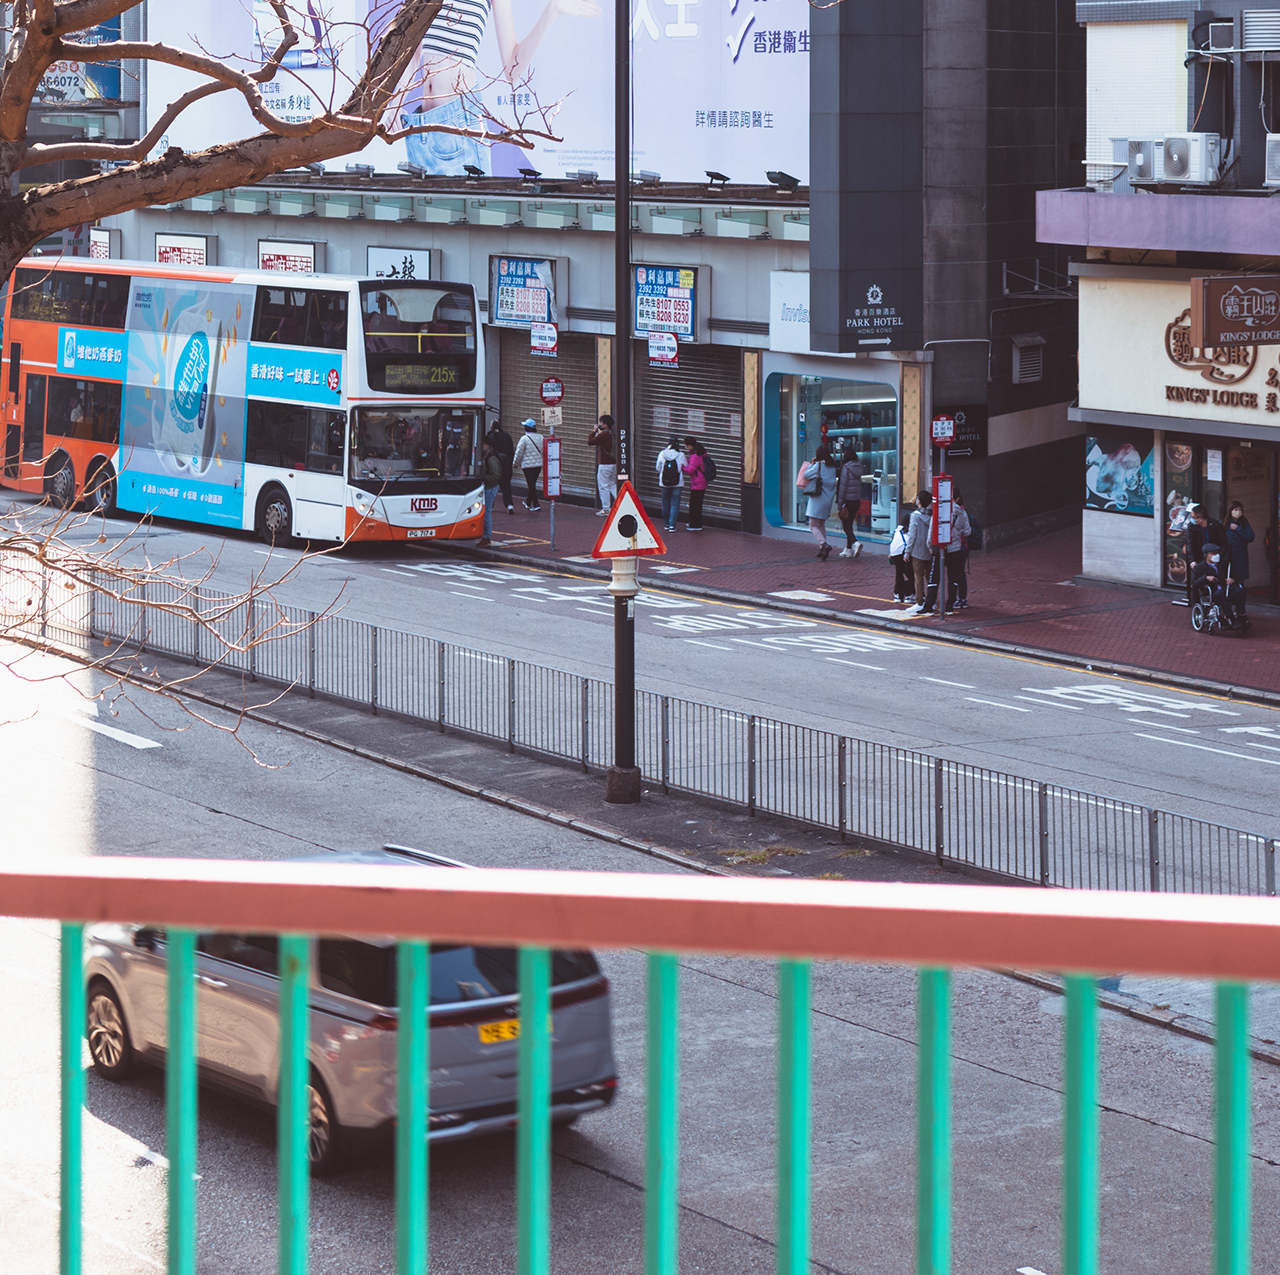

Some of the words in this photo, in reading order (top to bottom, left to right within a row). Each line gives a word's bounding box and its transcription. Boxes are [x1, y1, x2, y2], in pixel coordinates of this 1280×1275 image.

[695, 111, 774, 129] 詳情請諮詢醫生
[639, 285, 651, 293] 2392
[653, 286, 666, 294] 3392
[656, 299, 671, 310] 8107
[674, 300, 689, 312] 0553
[656, 310, 671, 322] 8208
[674, 312, 689, 324] 8230
[781, 303, 810, 323] Invis
[846, 318, 870, 327] PARK
[873, 317, 904, 327] HOTEL
[1220, 332, 1251, 342] KINGS'
[77, 344, 122, 363] 維他奶燕麥奶
[251, 363, 284, 381] 香滑好味
[1165, 385, 1209, 404] KINGS'
[1212, 390, 1258, 409] LODGE
[410, 498, 438, 511] KMB
